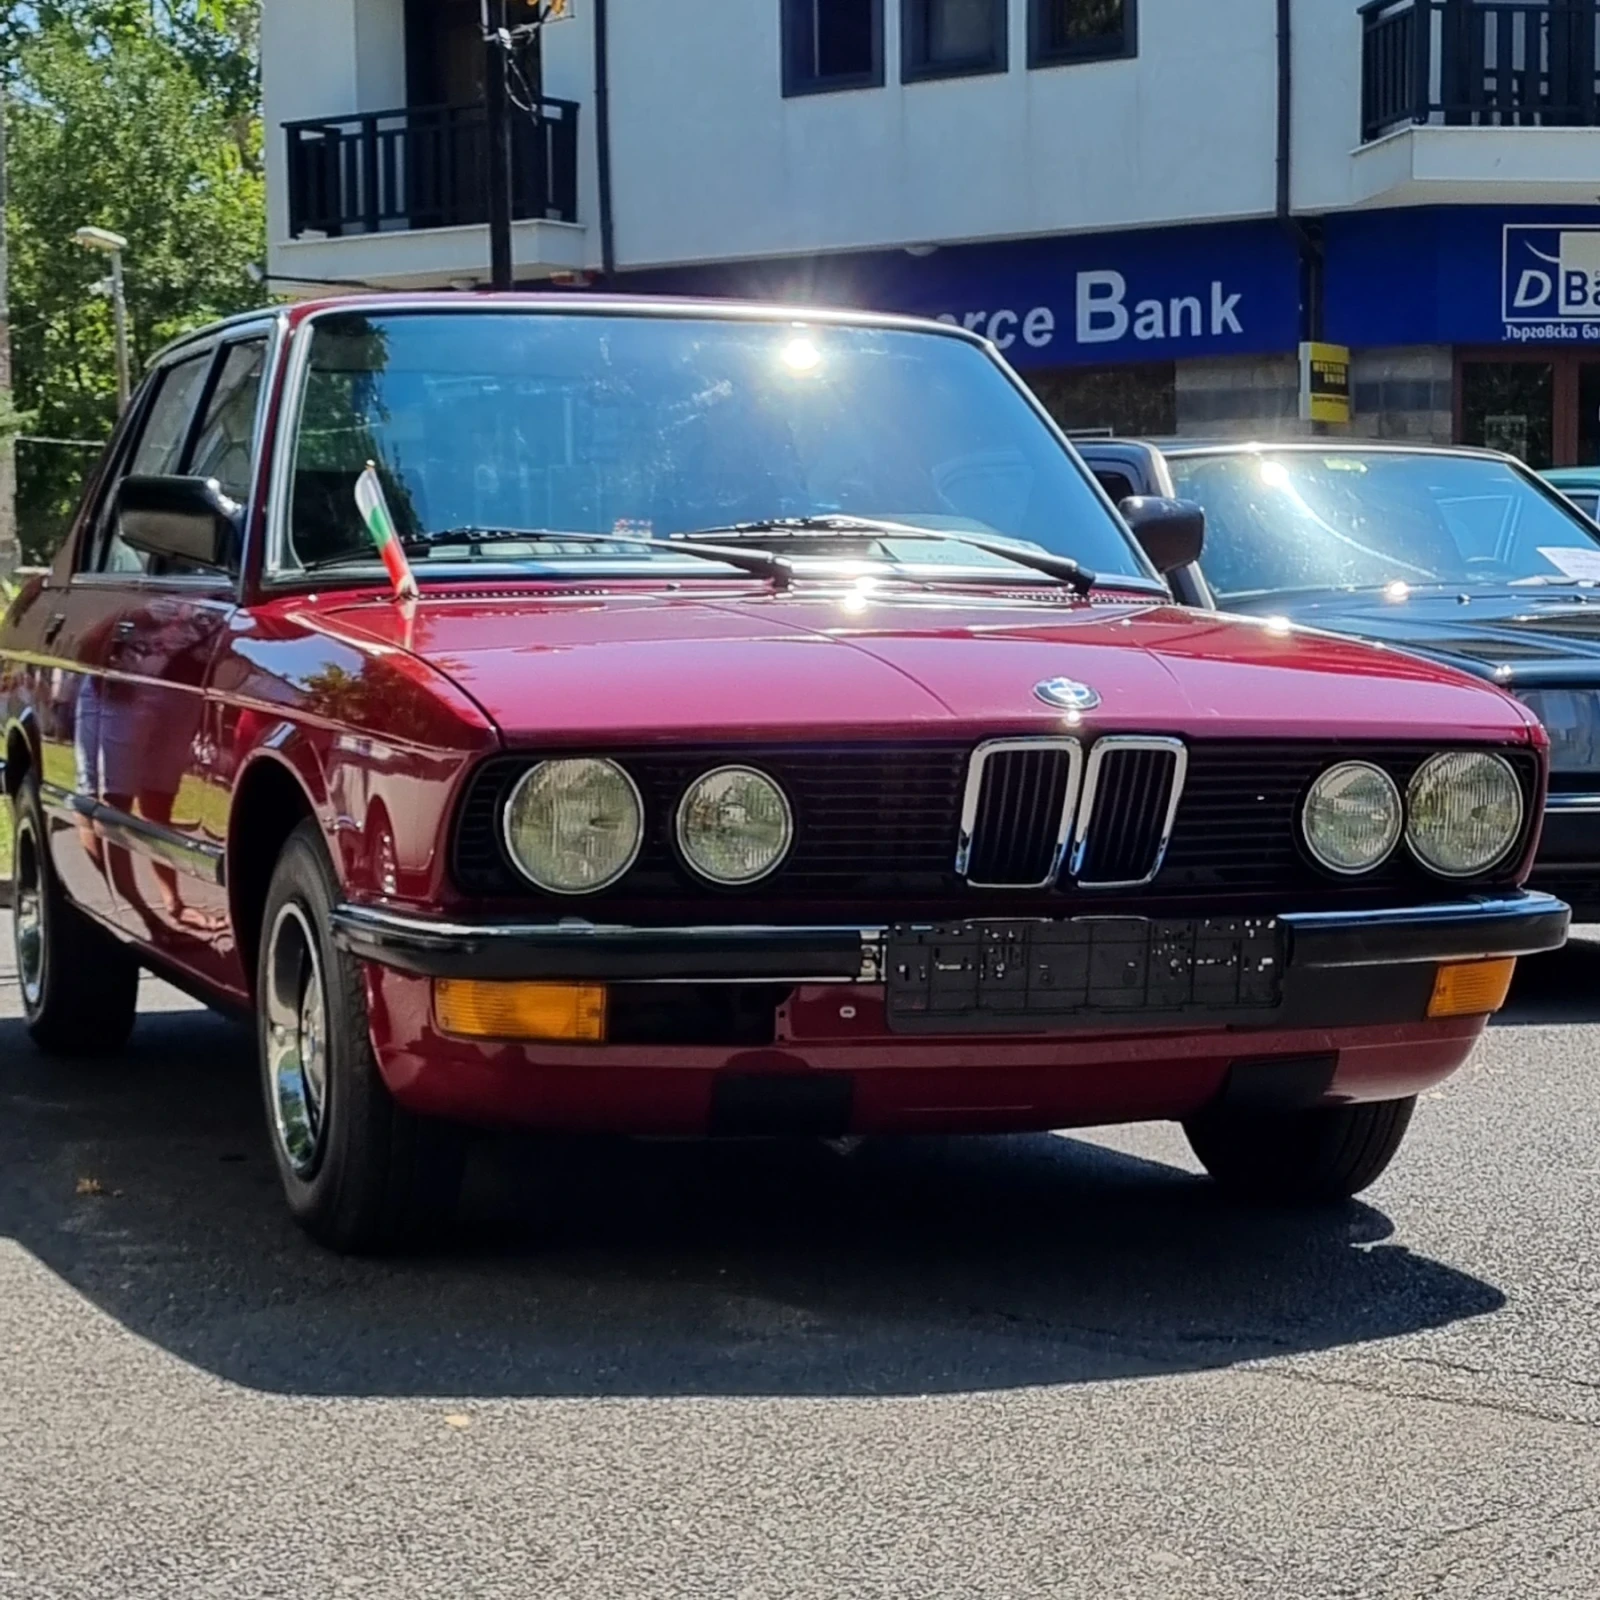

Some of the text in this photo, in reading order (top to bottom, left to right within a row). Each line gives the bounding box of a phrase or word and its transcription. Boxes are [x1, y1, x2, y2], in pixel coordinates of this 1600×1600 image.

[936, 270, 1243, 349] rce Bank
[1582, 324, 1600, 338] ба
